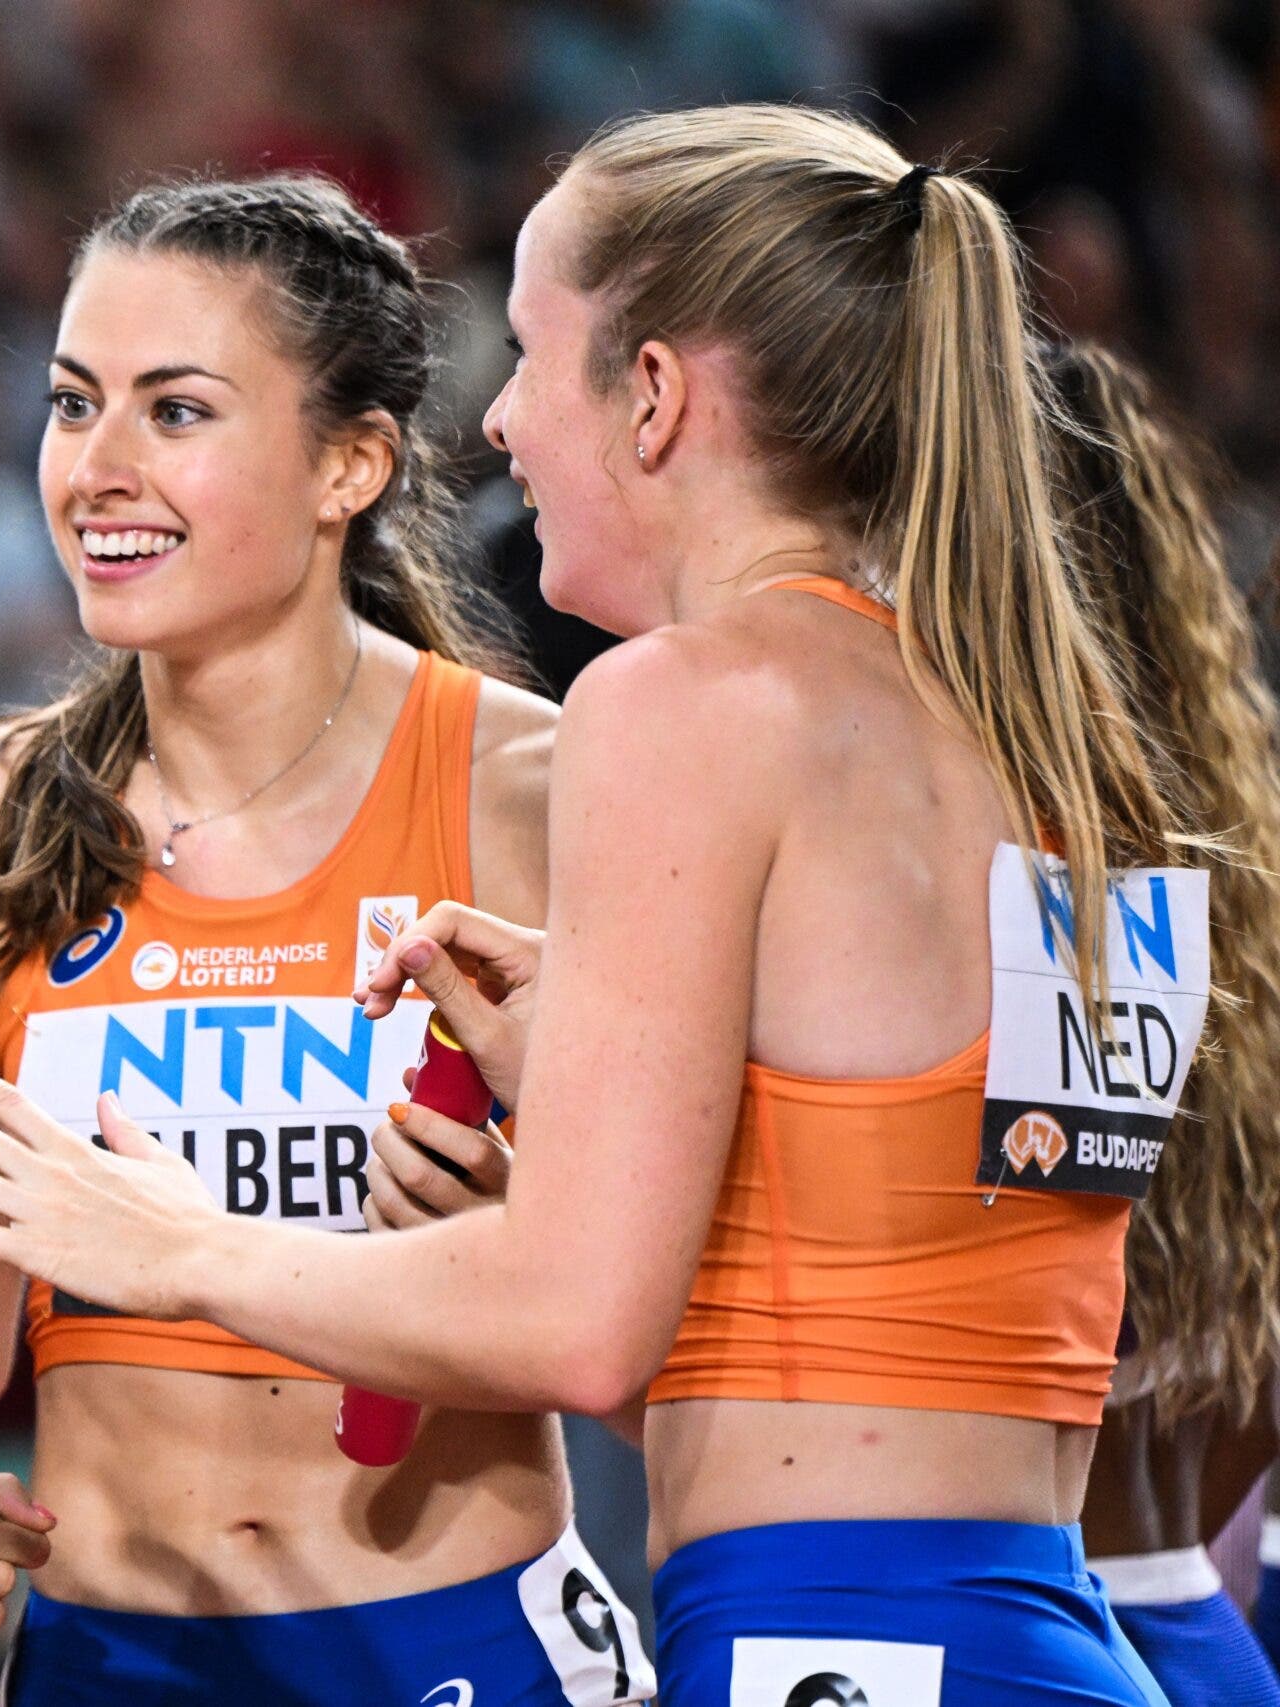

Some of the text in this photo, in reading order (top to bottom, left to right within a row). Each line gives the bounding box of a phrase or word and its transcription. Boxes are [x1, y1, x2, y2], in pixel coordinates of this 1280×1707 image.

[182, 943, 329, 967] NEDERLANDSE
[1032, 862, 1177, 984] NN
[179, 966, 276, 987] LOTERIJ
[100, 1005, 374, 1108] NTN
[1057, 991, 1177, 1100] NED
